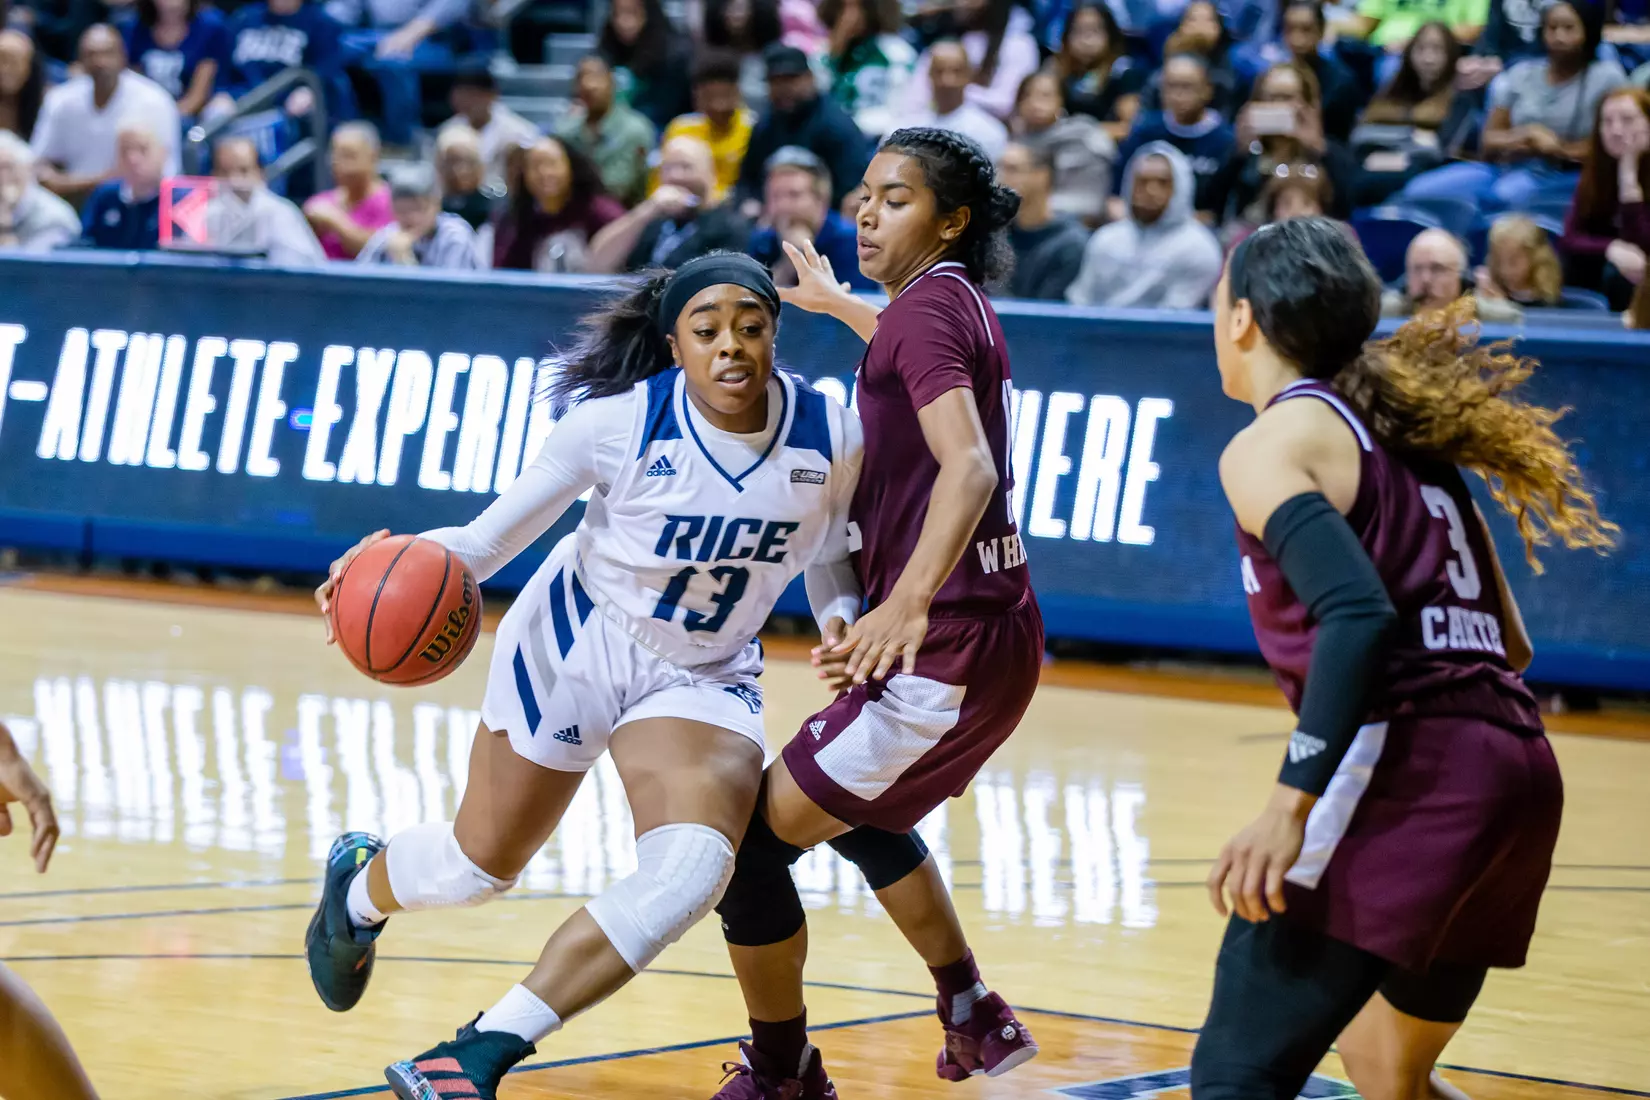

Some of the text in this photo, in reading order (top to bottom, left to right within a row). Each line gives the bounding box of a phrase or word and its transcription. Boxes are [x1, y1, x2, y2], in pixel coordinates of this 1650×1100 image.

[646, 468, 677, 477] adidas
[654, 514, 801, 564] RICE
[1419, 484, 1482, 600] 3
[651, 565, 751, 633] 13
[1420, 605, 1508, 659] CARTE
[552, 732, 583, 746] adidas
